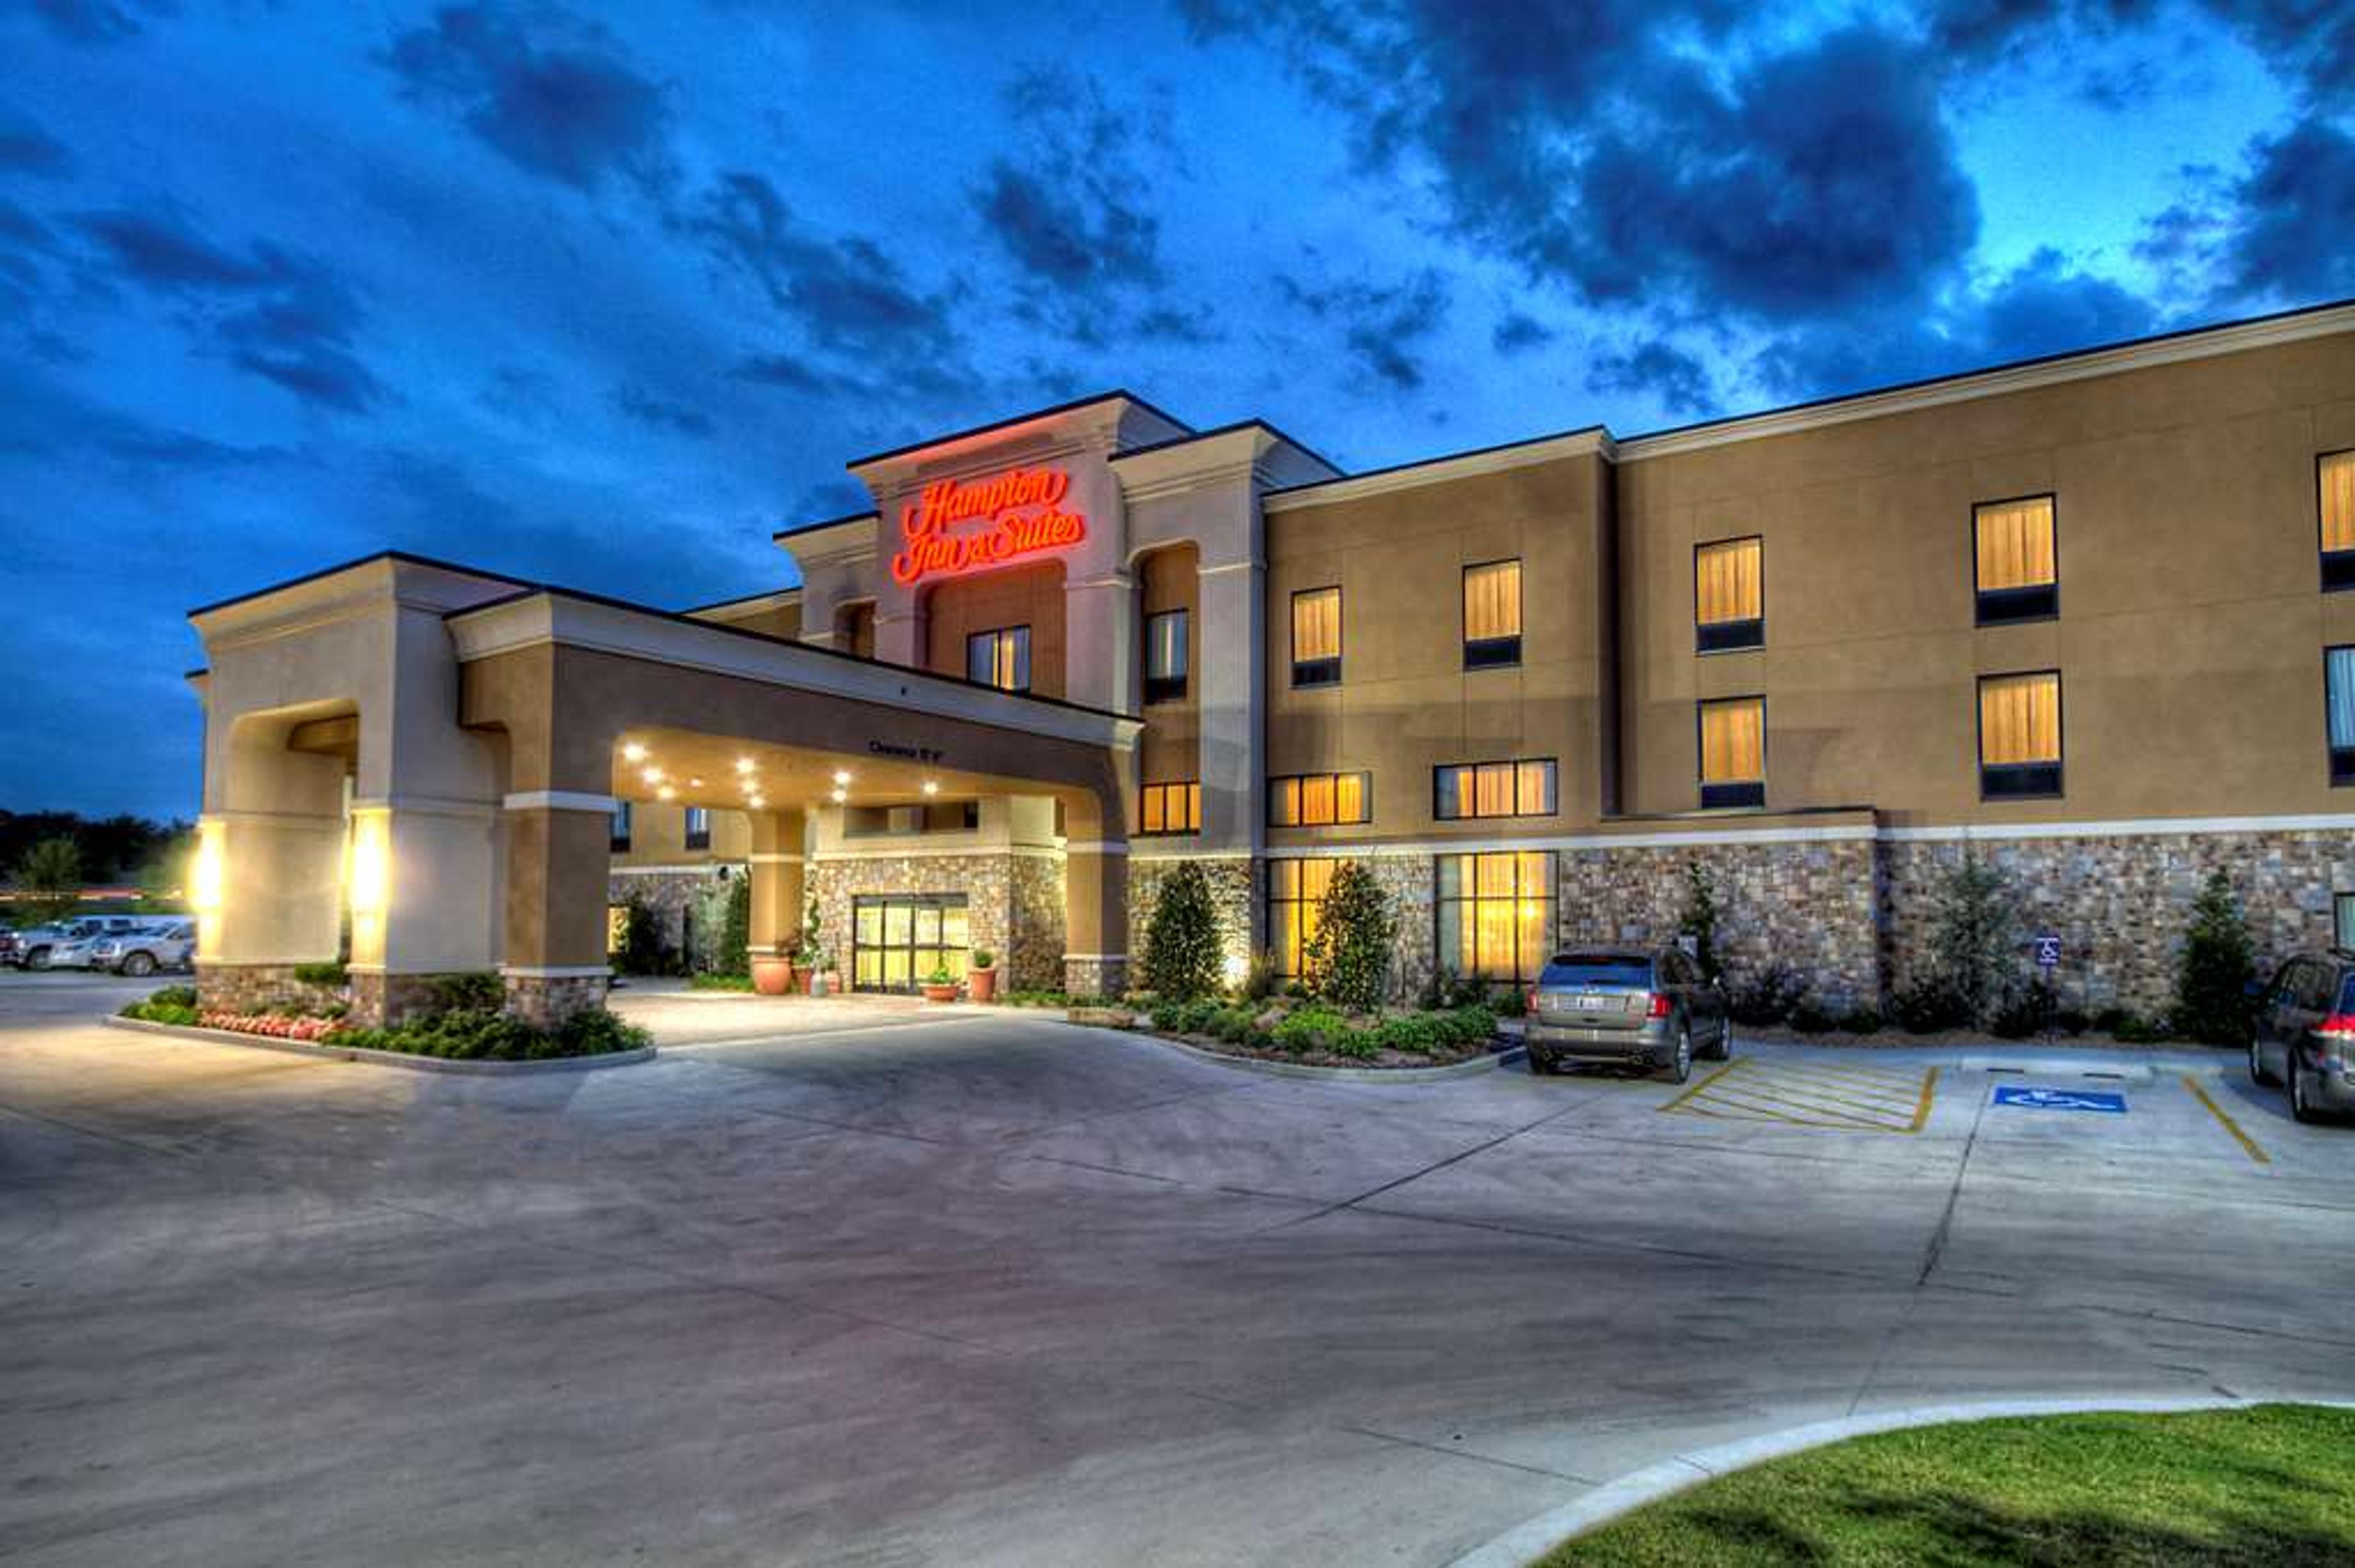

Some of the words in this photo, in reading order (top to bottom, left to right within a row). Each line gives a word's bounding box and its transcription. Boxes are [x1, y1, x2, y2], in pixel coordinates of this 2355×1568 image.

[904, 469, 1068, 535] Hampton
[893, 533, 969, 581] Inn
[988, 510, 1085, 558] Suites
